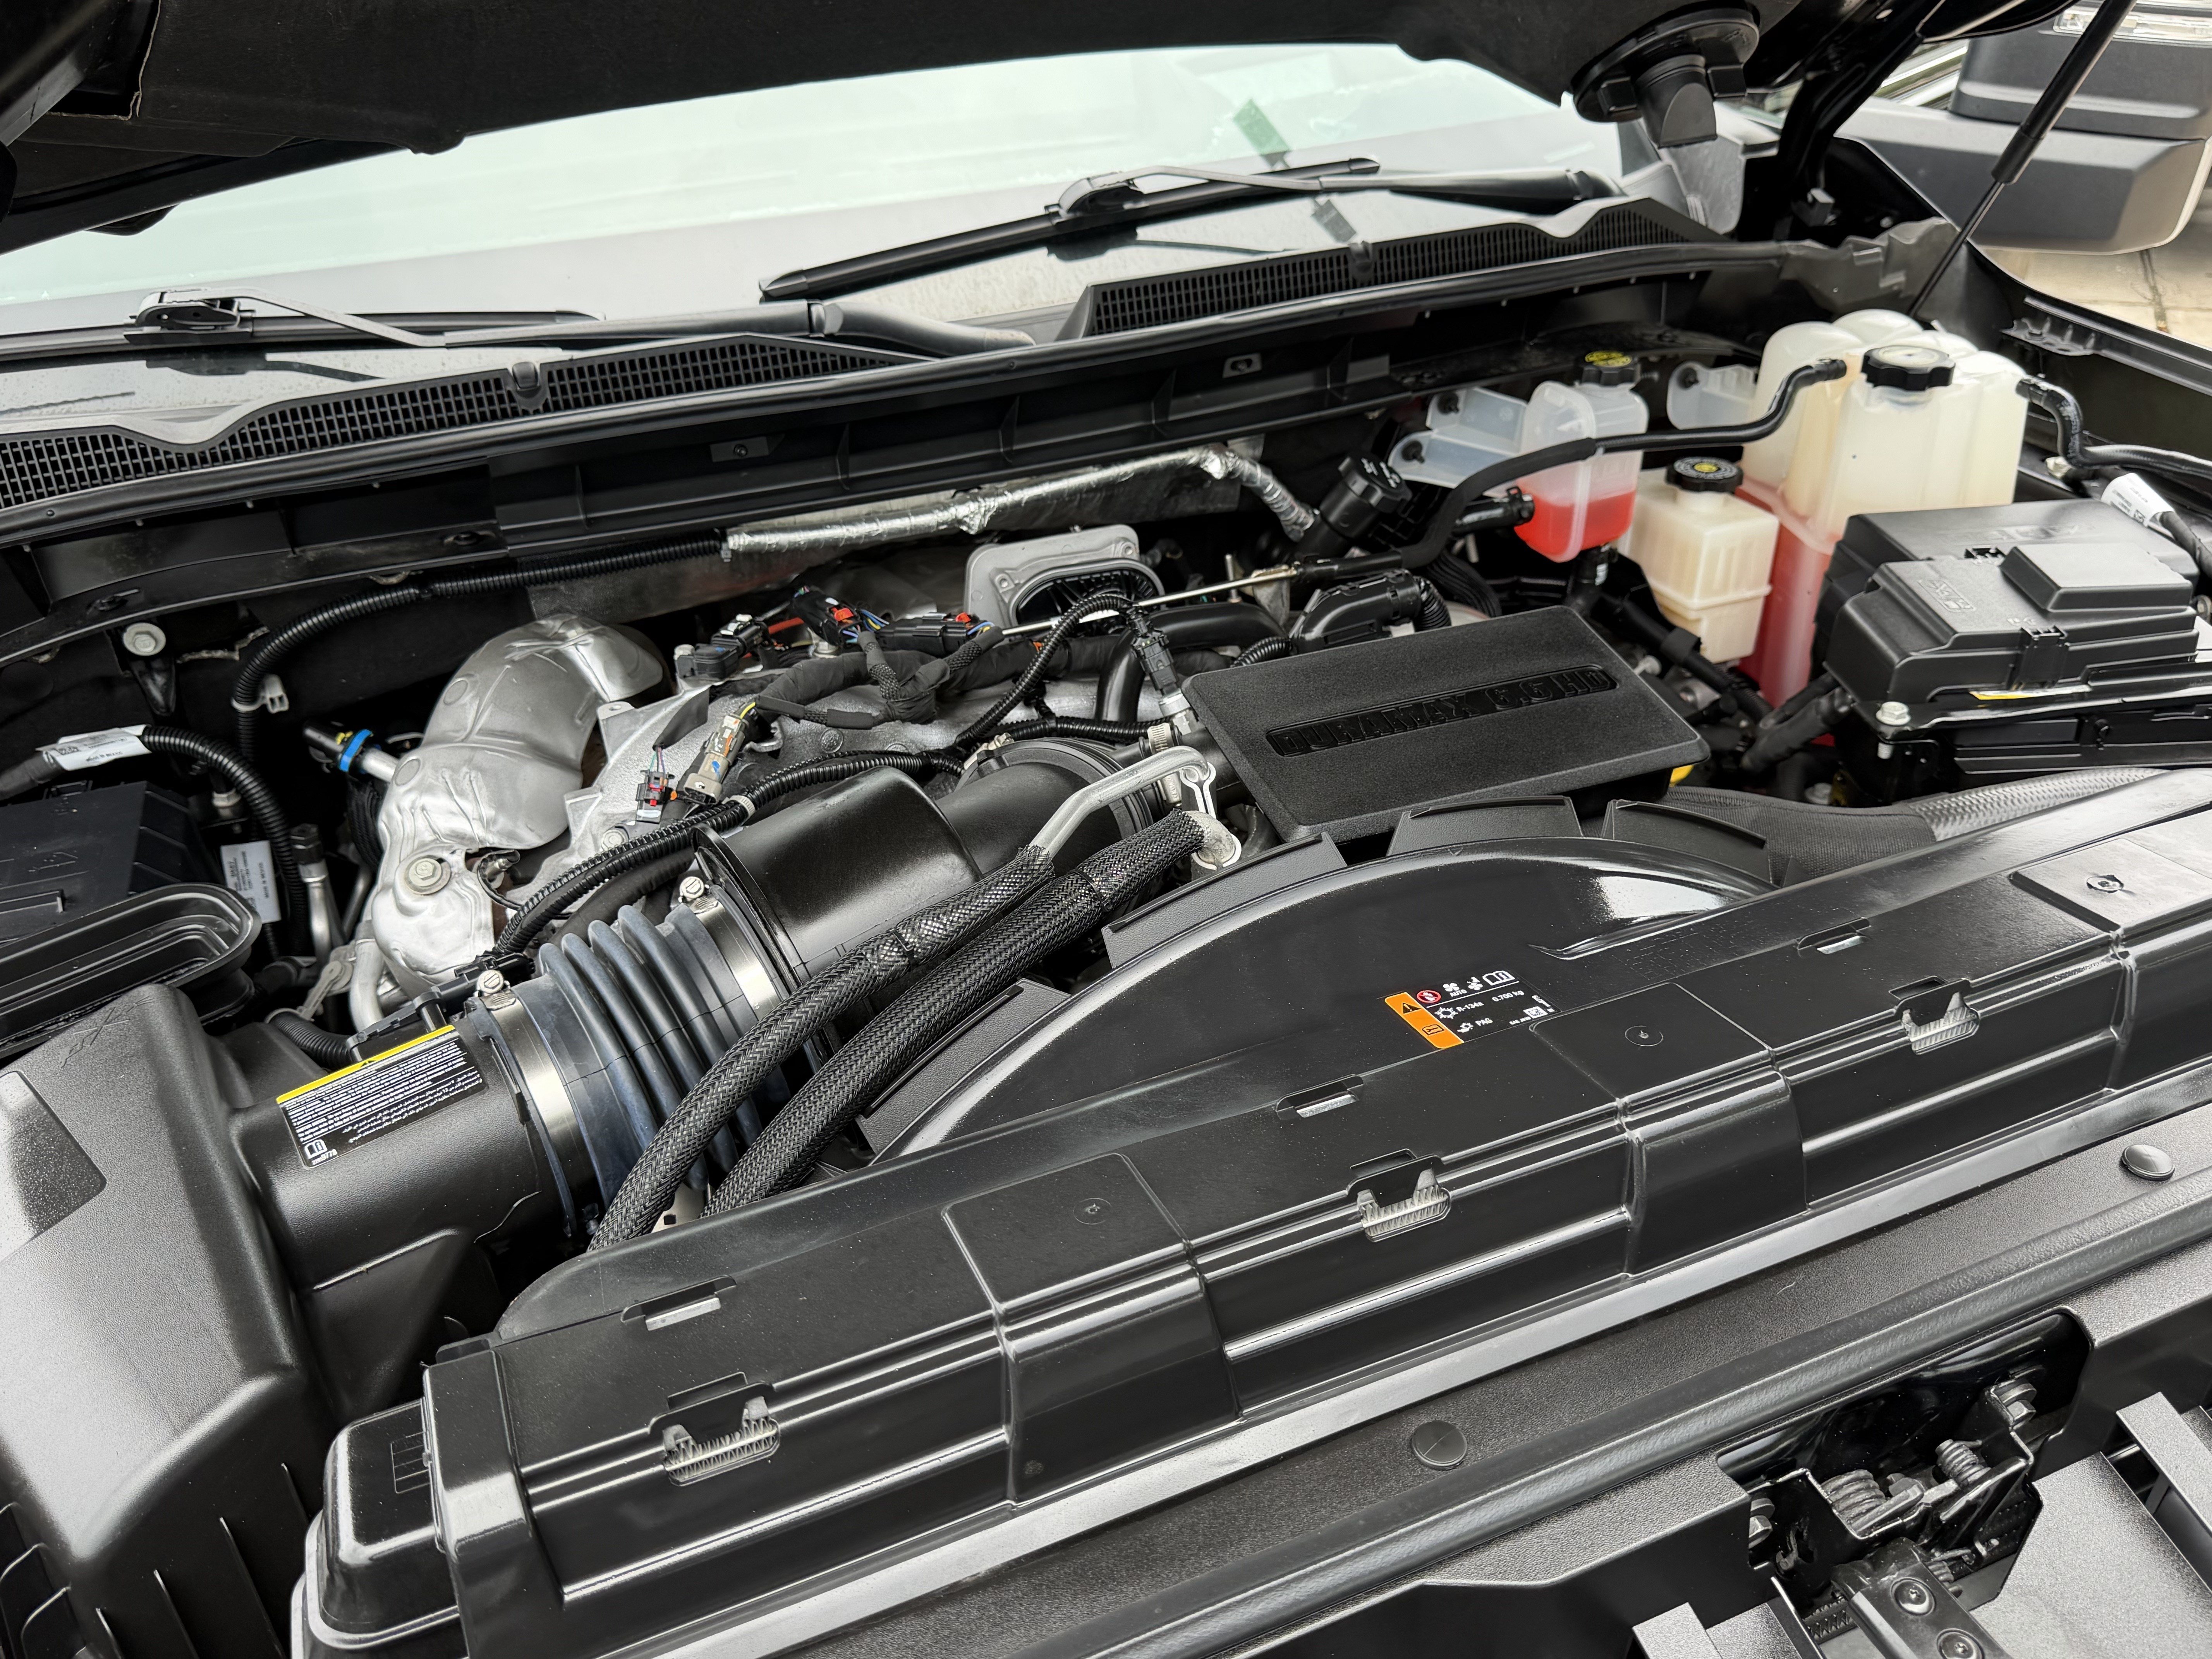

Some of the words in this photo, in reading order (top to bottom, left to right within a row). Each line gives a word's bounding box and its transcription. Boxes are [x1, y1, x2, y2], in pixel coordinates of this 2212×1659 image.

[1272, 693, 1480, 757] DURAMAX
[1486, 679, 1553, 711] 6.6
[1550, 670, 1610, 696] HD
[1449, 989, 1467, 997] AUTO
[1456, 1001, 1484, 1012] R-134a
[1492, 992, 1513, 1002] 0.700
[1475, 1018, 1494, 1026] PAG
